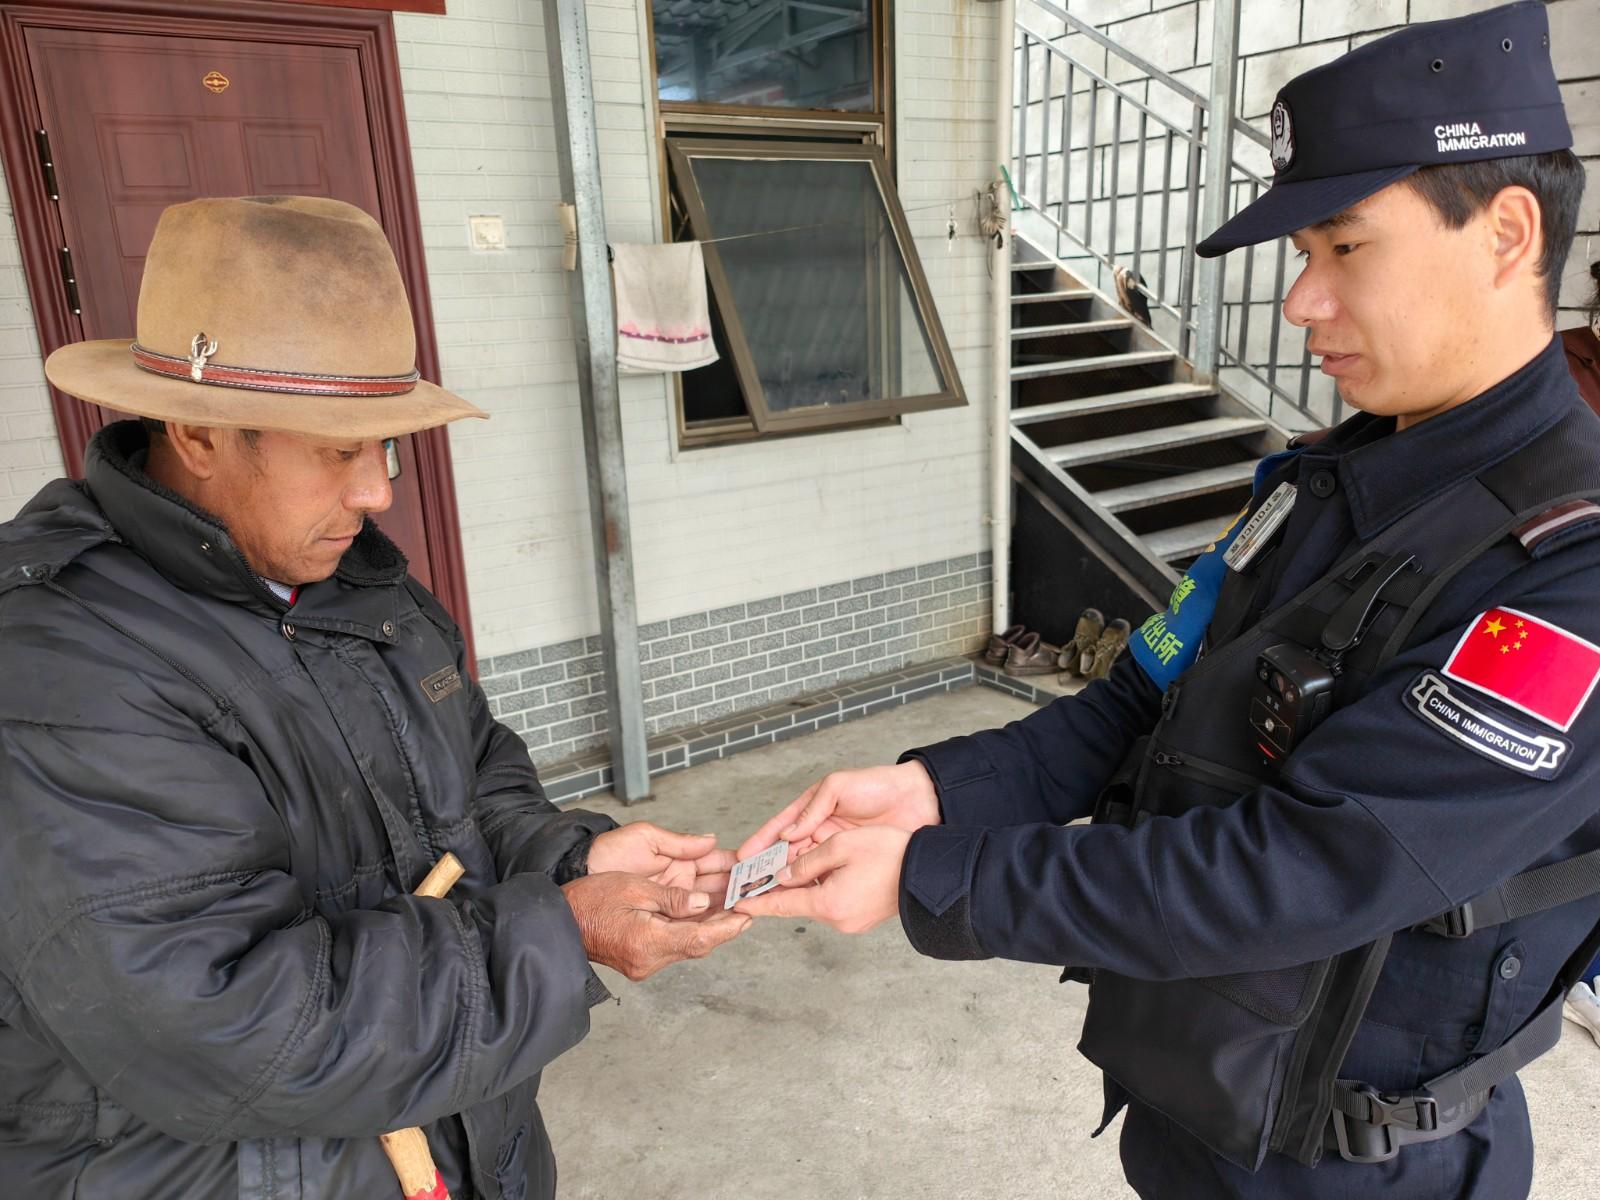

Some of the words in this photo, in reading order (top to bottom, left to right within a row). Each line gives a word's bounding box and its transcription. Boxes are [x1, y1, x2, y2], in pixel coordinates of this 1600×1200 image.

[1434, 122, 1481, 139] CHINA
[1437, 132, 1526, 152] IMMIGRATION
[1238, 502, 1272, 542] POLICE
[1429, 697, 1461, 723] CHINA
[1461, 718, 1537, 760] IMMIGRATION
